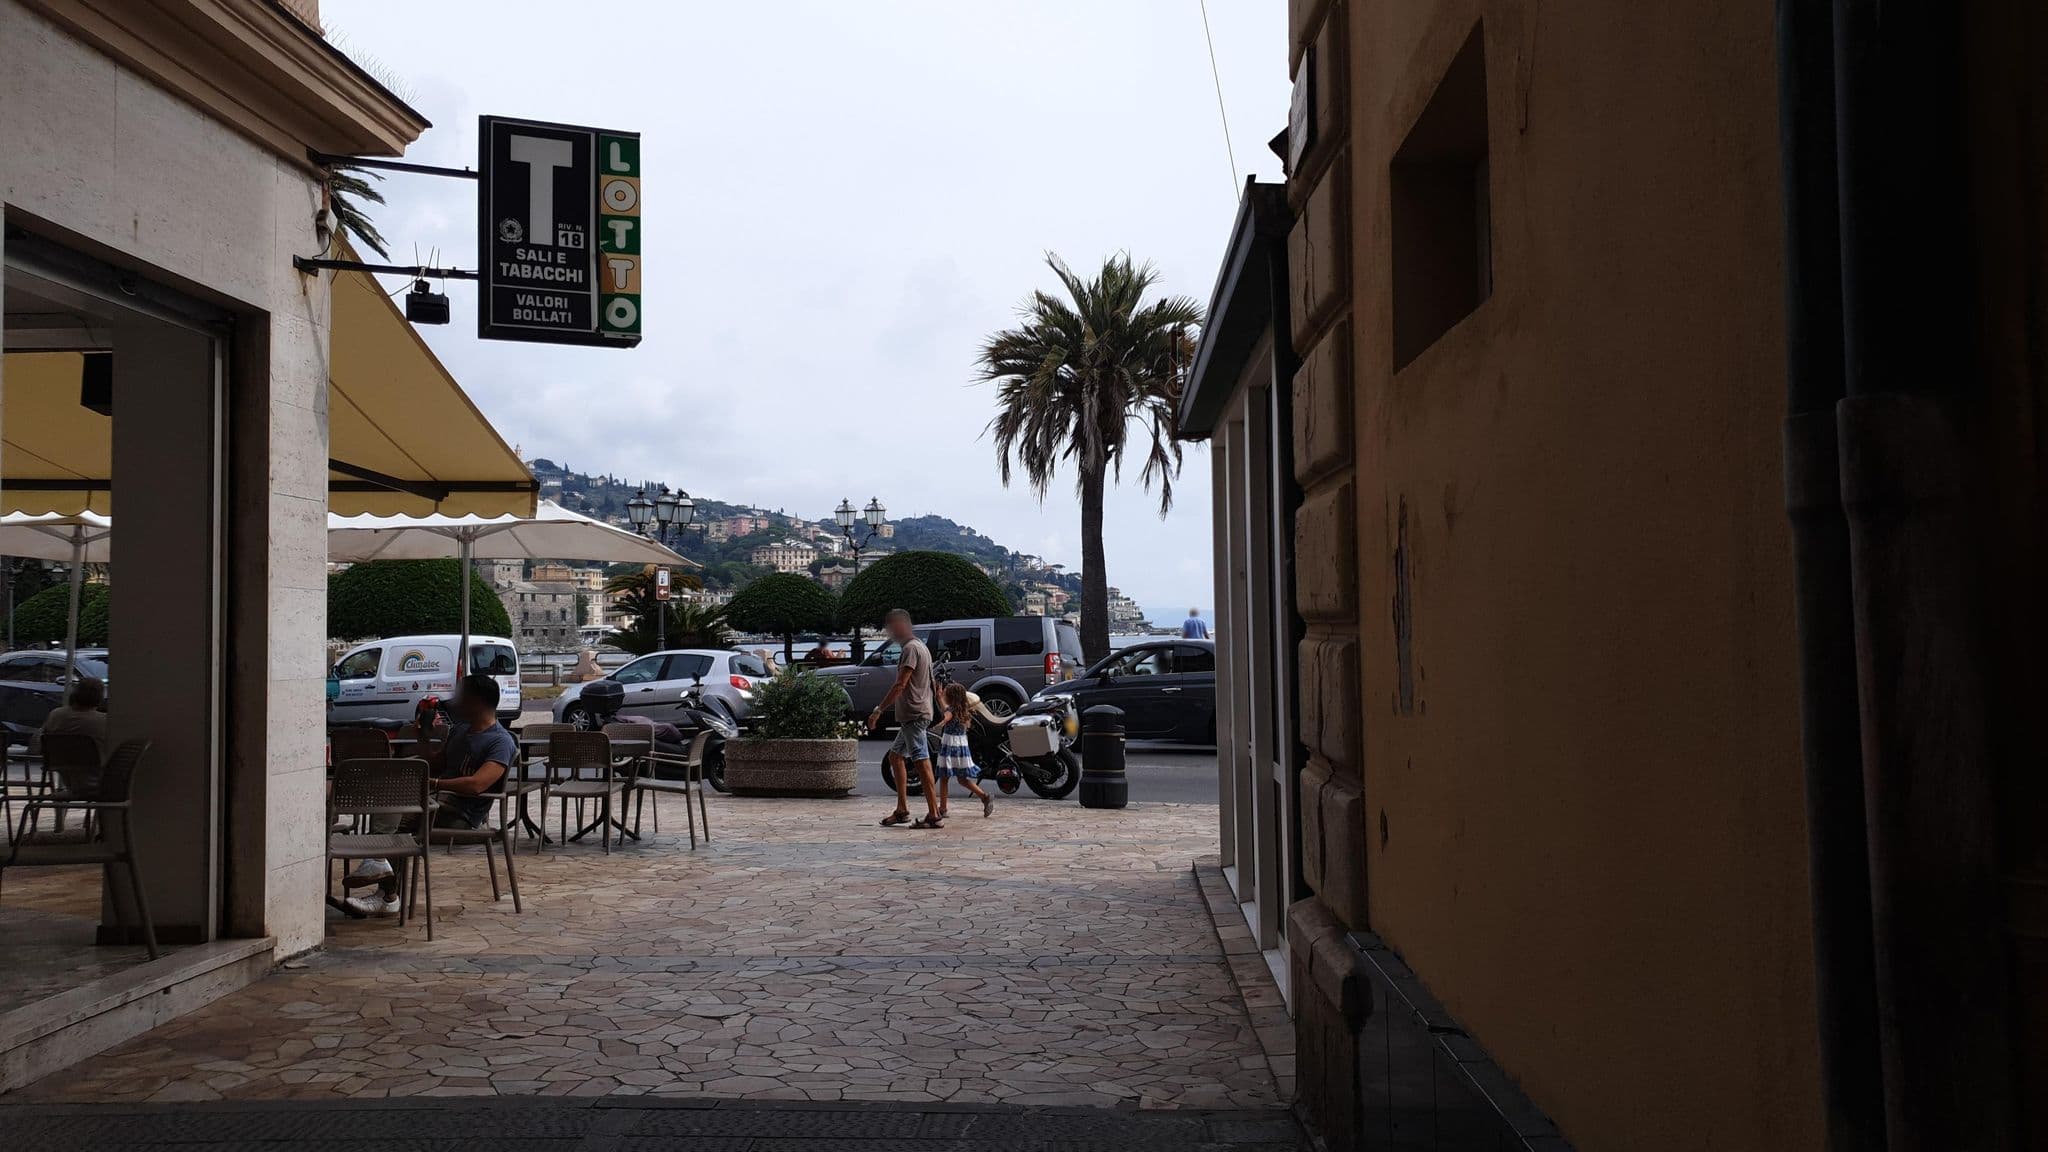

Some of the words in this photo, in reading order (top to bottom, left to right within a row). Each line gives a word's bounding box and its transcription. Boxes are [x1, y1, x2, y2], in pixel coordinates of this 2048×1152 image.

[510, 134, 573, 246] T
[558, 223, 573, 231] RIV.
[575, 224, 584, 232] N.
[603, 141, 638, 329] LOTTO
[560, 232, 582, 248] 18
[516, 248, 552, 263] SALI
[557, 252, 567, 264] E
[500, 262, 583, 283] TABACCHI
[516, 293, 569, 309] VALORI
[513, 308, 572, 324] BOLLATI
